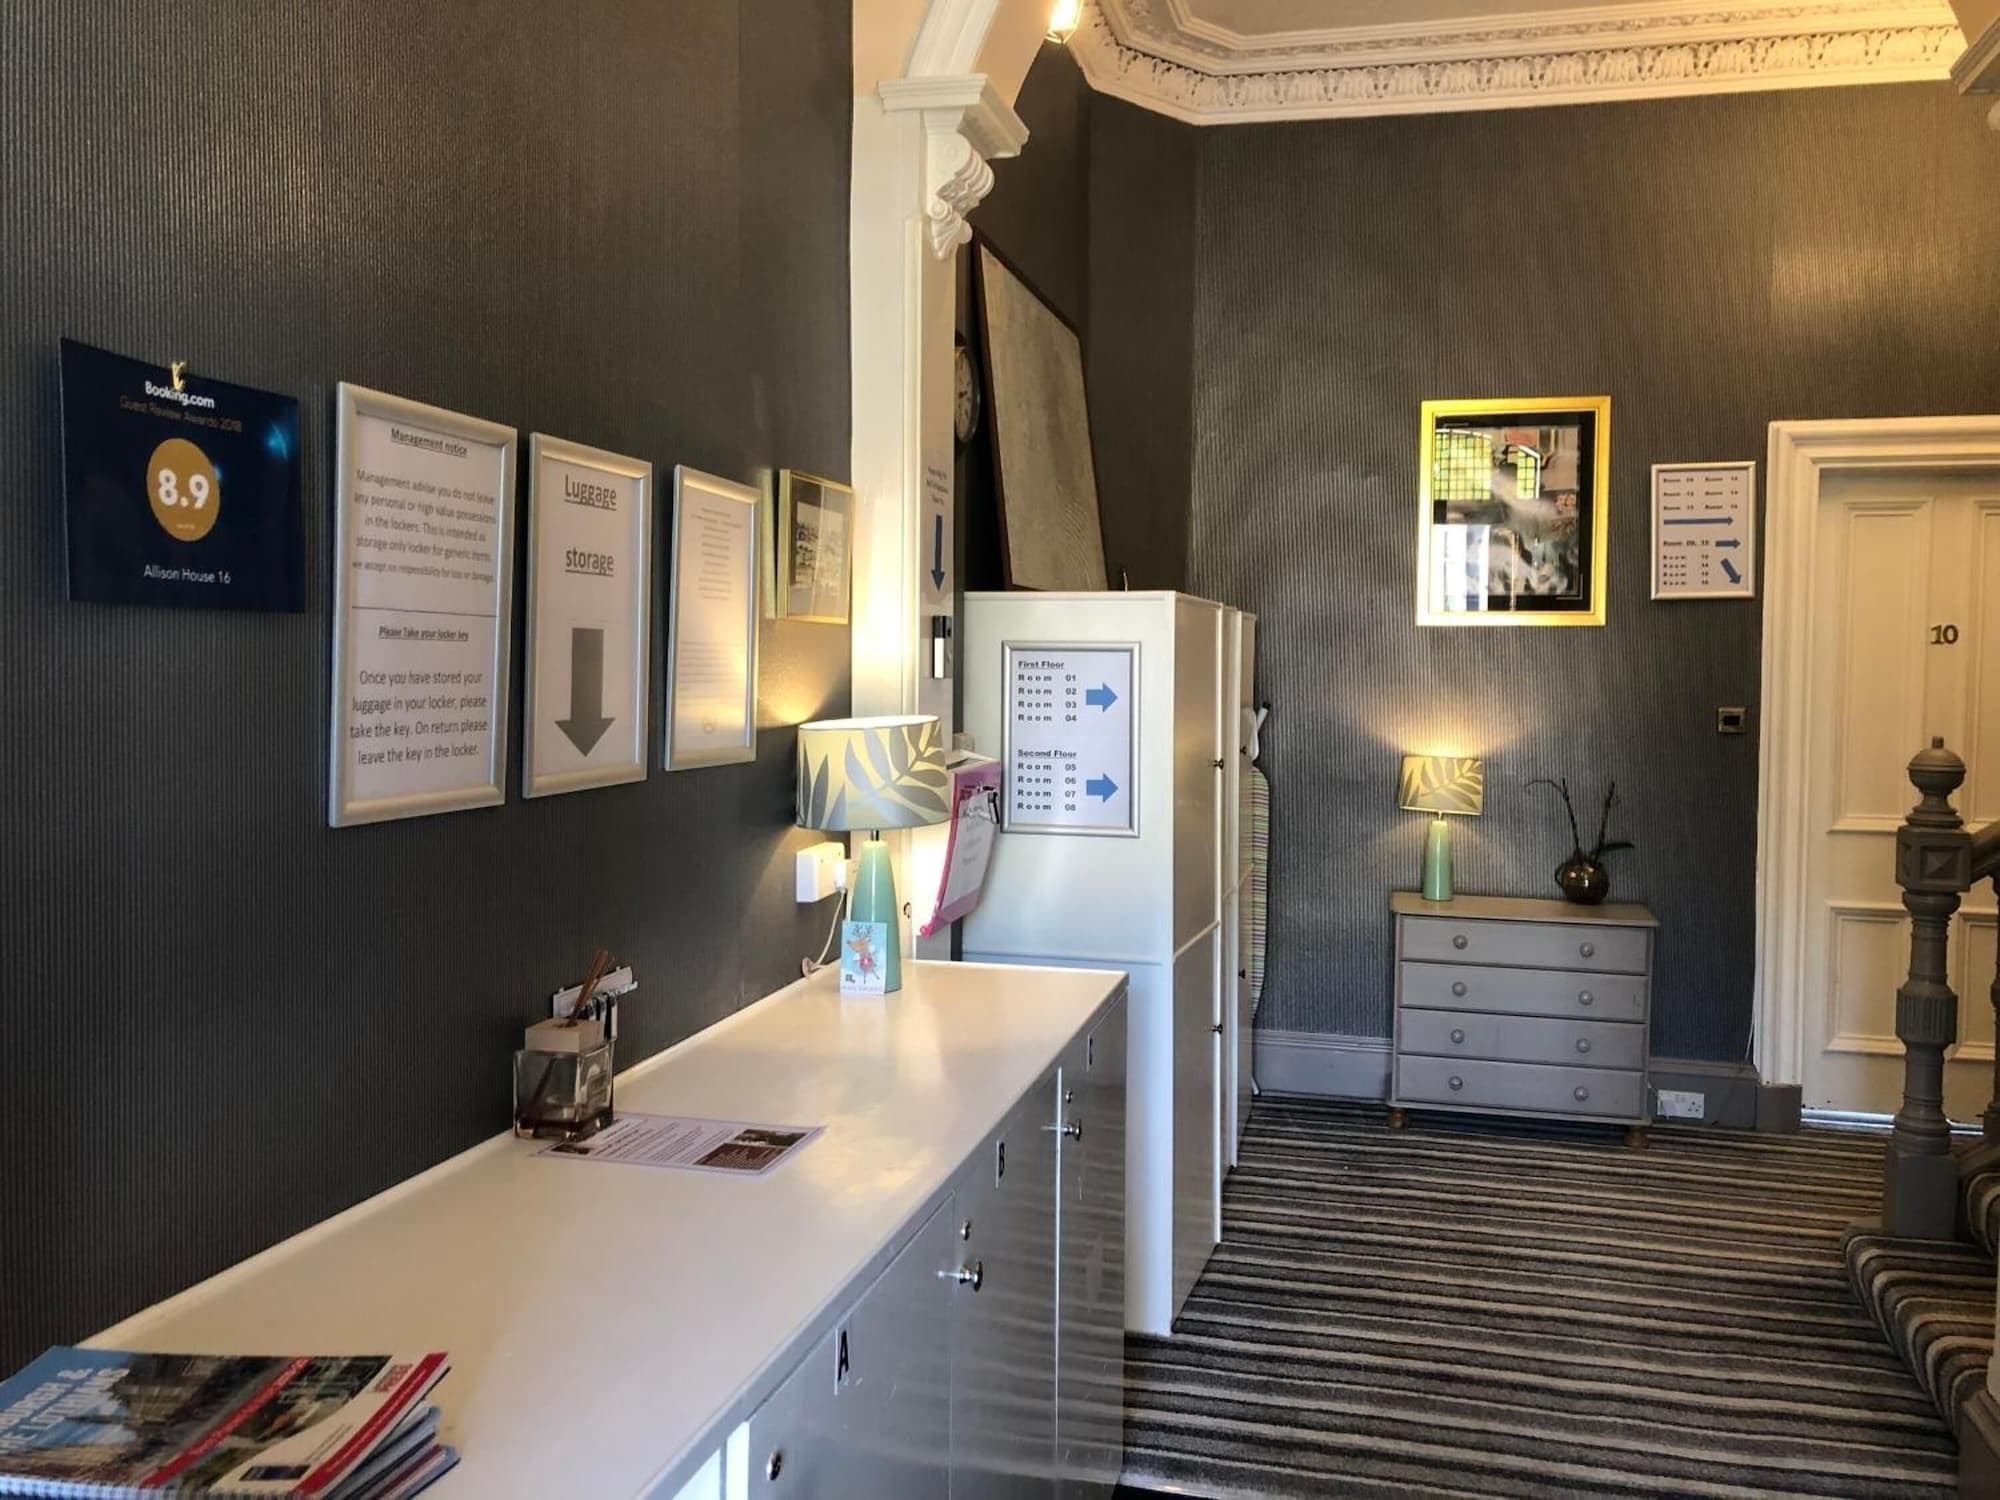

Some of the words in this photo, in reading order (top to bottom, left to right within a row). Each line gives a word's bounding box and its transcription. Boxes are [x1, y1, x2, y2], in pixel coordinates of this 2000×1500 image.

[145, 381, 215, 408] Booking.com
[391, 428, 443, 451] Management
[445, 442, 467, 457] notice
[158, 469, 209, 509] 8.9
[357, 469, 410, 490] Management
[438, 486, 451, 498] you
[453, 488, 461, 499] do
[463, 491, 475, 501] not
[564, 474, 617, 509] Luggage
[354, 492, 368, 506] any
[371, 495, 405, 511] personal
[407, 502, 415, 511] or
[417, 501, 434, 517] high
[365, 516, 373, 526] in
[375, 515, 388, 529] the
[356, 536, 387, 551] storage
[565, 547, 614, 576] storage
[144, 564, 179, 580] Allison
[182, 568, 215, 583] House
[218, 570, 231, 585] 16
[1930, 624, 1959, 645] 10
[1018, 660, 1039, 669] First
[1041, 660, 1065, 669] Floor
[360, 669, 386, 685] Once
[389, 673, 406, 687] you
[409, 671, 430, 684] have
[433, 671, 461, 684] stored
[463, 672, 482, 686] your
[1065, 673, 1077, 682] 01
[1065, 687, 1077, 696] 02
[352, 695, 392, 715] luggage
[394, 696, 403, 710] in
[405, 699, 426, 712] your
[460, 694, 487, 710] please
[1065, 700, 1077, 709] 03
[1065, 713, 1077, 722] 04
[350, 723, 372, 739] take
[375, 721, 391, 737] the
[415, 720, 429, 735] On
[431, 721, 459, 734] return
[461, 720, 487, 736] please
[358, 749, 385, 765] leave
[387, 747, 403, 762] the
[406, 746, 421, 764] key
[424, 747, 433, 760] in
[434, 744, 449, 758] the
[1017, 750, 1052, 759] Second
[1054, 750, 1077, 759] Floor
[1065, 789, 1077, 798] 07
[999, 1142, 1005, 1179] B
[838, 1330, 849, 1381] A
